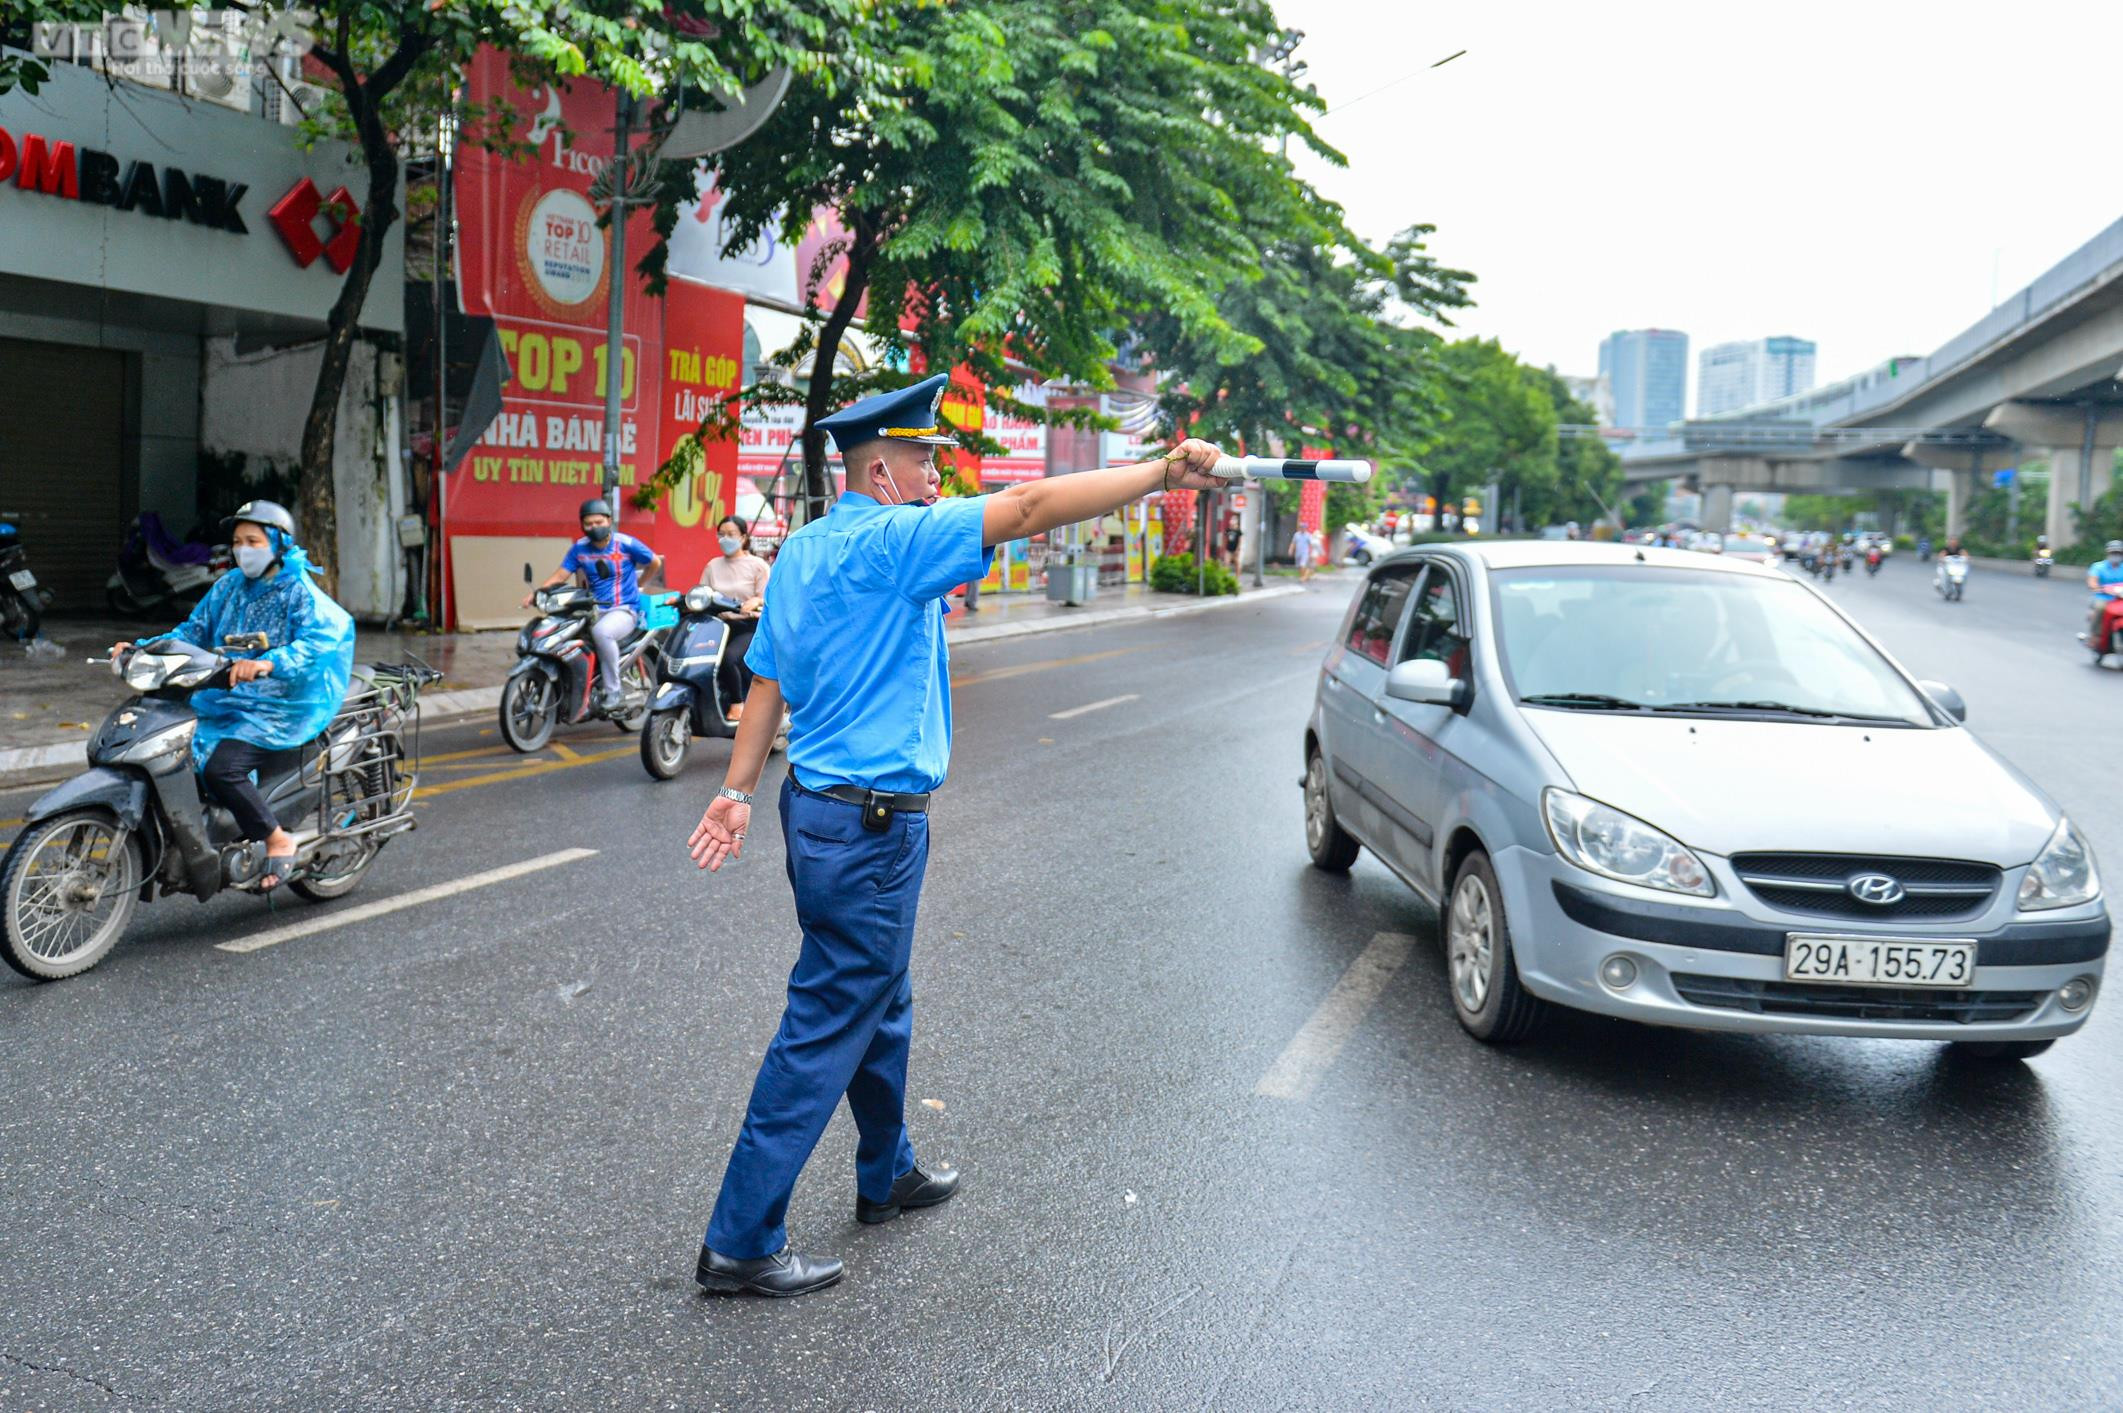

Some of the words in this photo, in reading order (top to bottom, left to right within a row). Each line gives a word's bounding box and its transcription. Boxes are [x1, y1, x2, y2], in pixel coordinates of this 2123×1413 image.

[546, 221, 574, 239] TOP
[544, 239, 590, 265] RETAIL
[669, 345, 700, 384] TRẢ
[705, 353, 737, 390] GÓP
[476, 410, 539, 448] NHÀ
[546, 414, 603, 452] BÁN
[473, 456, 502, 481] UY
[508, 454, 544, 483] TÍN
[549, 459, 591, 486] VIỆT
[594, 460, 635, 486] NM
